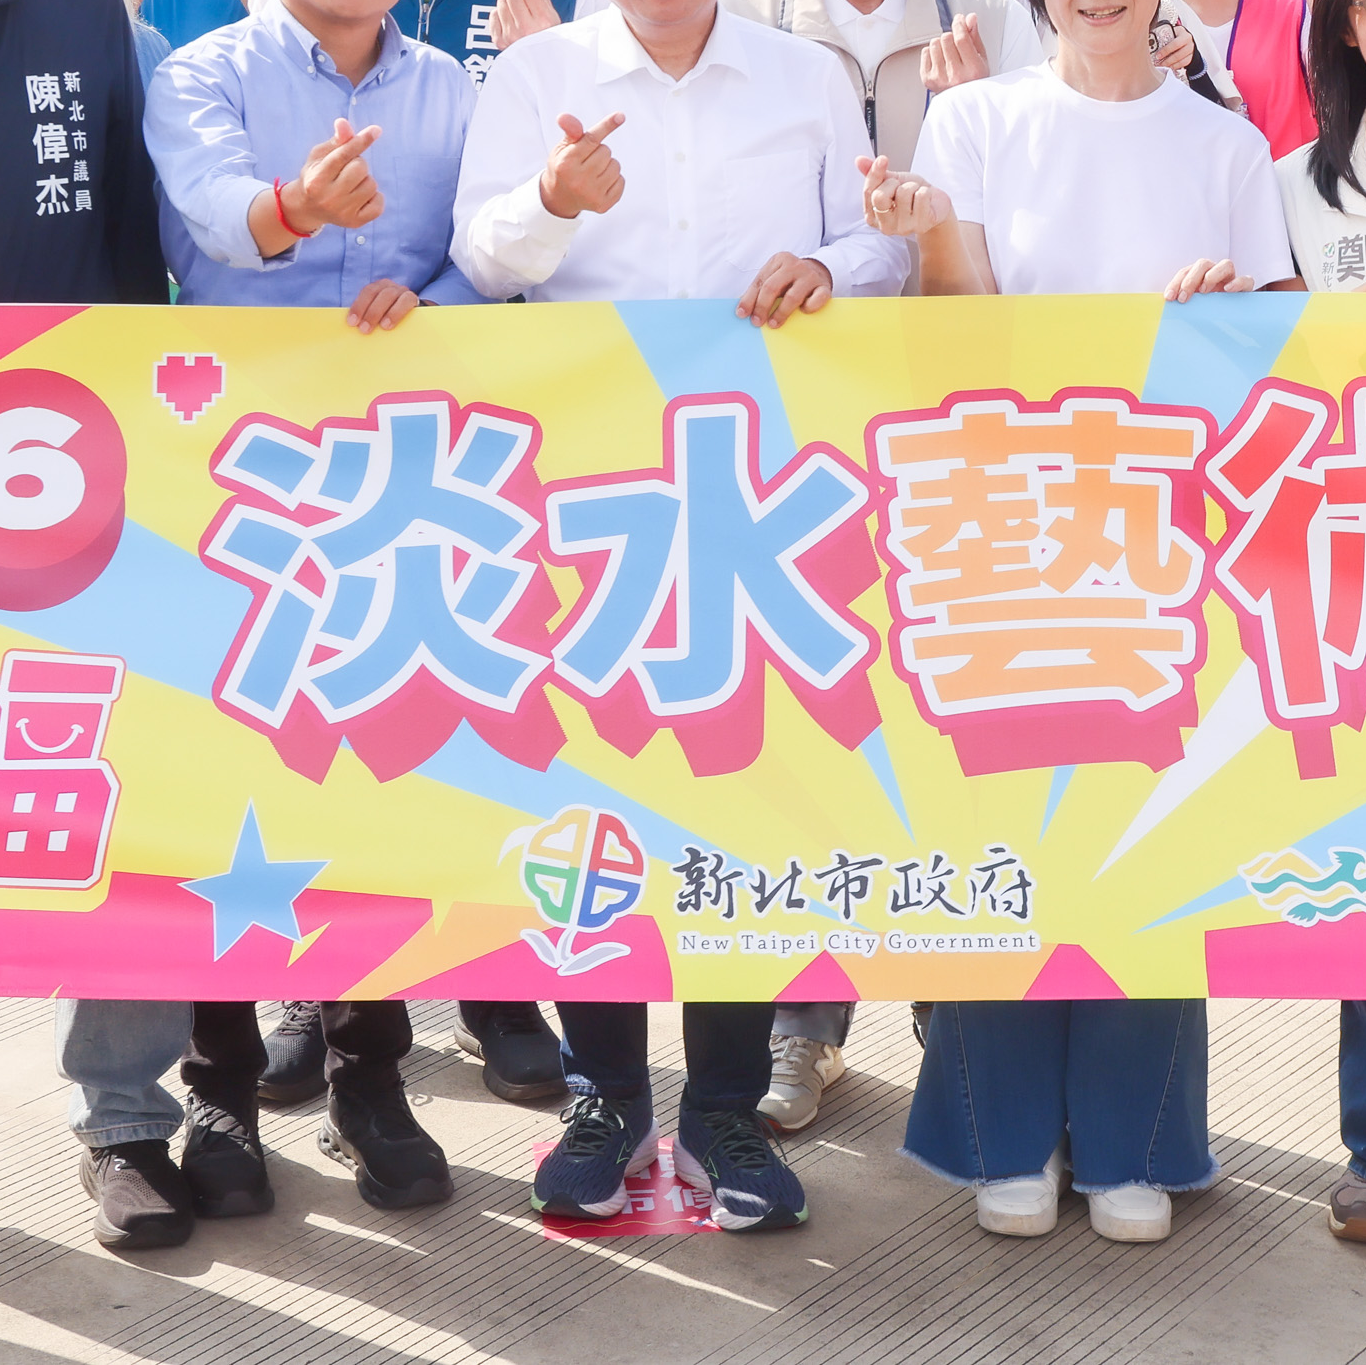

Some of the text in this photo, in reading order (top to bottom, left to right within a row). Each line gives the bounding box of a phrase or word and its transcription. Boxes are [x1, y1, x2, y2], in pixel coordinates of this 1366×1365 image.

[26, 73, 70, 216] 陳偉杰
[63, 71, 92, 212] 新北市議員
[673, 847, 1032, 921] 新北市政府
[681, 933, 1037, 954] New Taipei City Government
